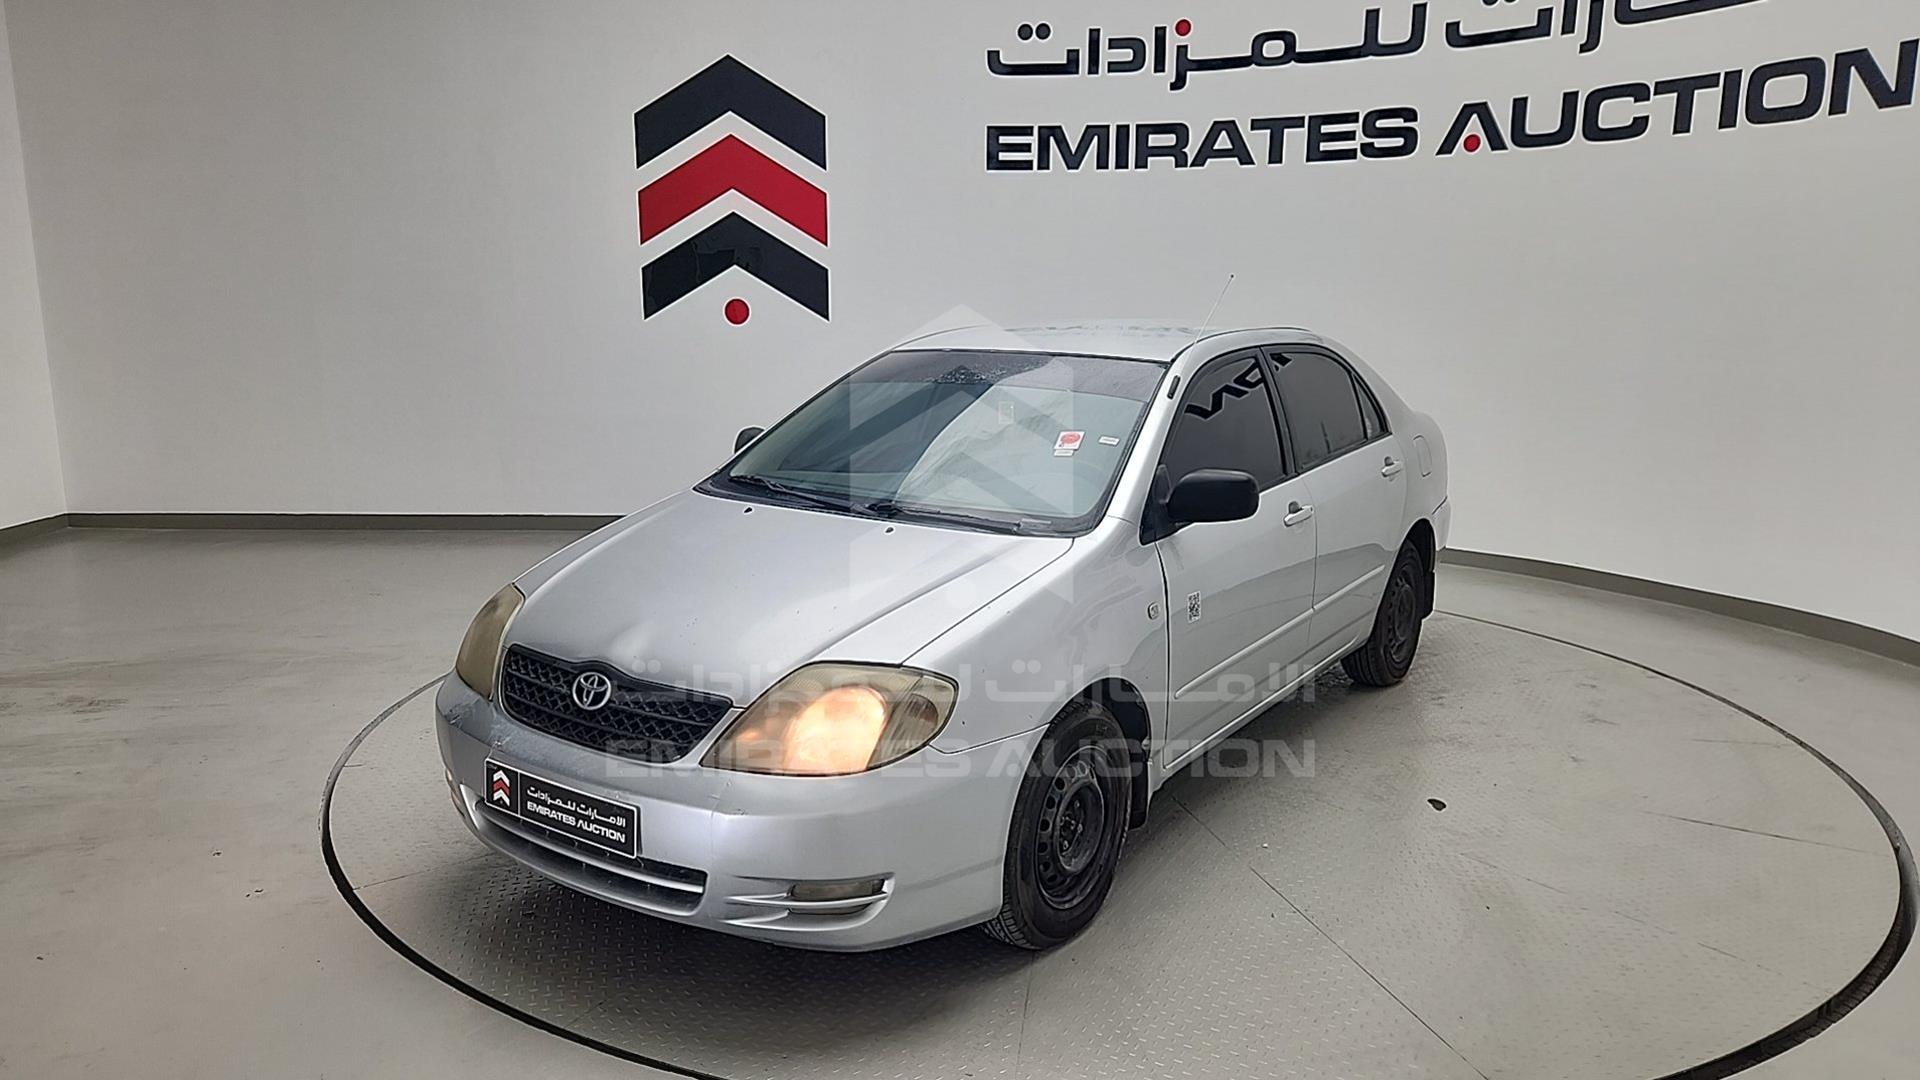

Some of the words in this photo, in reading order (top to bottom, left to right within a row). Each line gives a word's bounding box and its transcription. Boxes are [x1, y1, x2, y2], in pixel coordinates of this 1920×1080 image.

[987, 3, 1427, 90] للمزادات
[986, 107, 1418, 171] EMIRATES
[1435, 38, 1919, 156] AUCTION
[526, 800, 577, 826] EMIRATES
[576, 819, 626, 844] AUCTION
